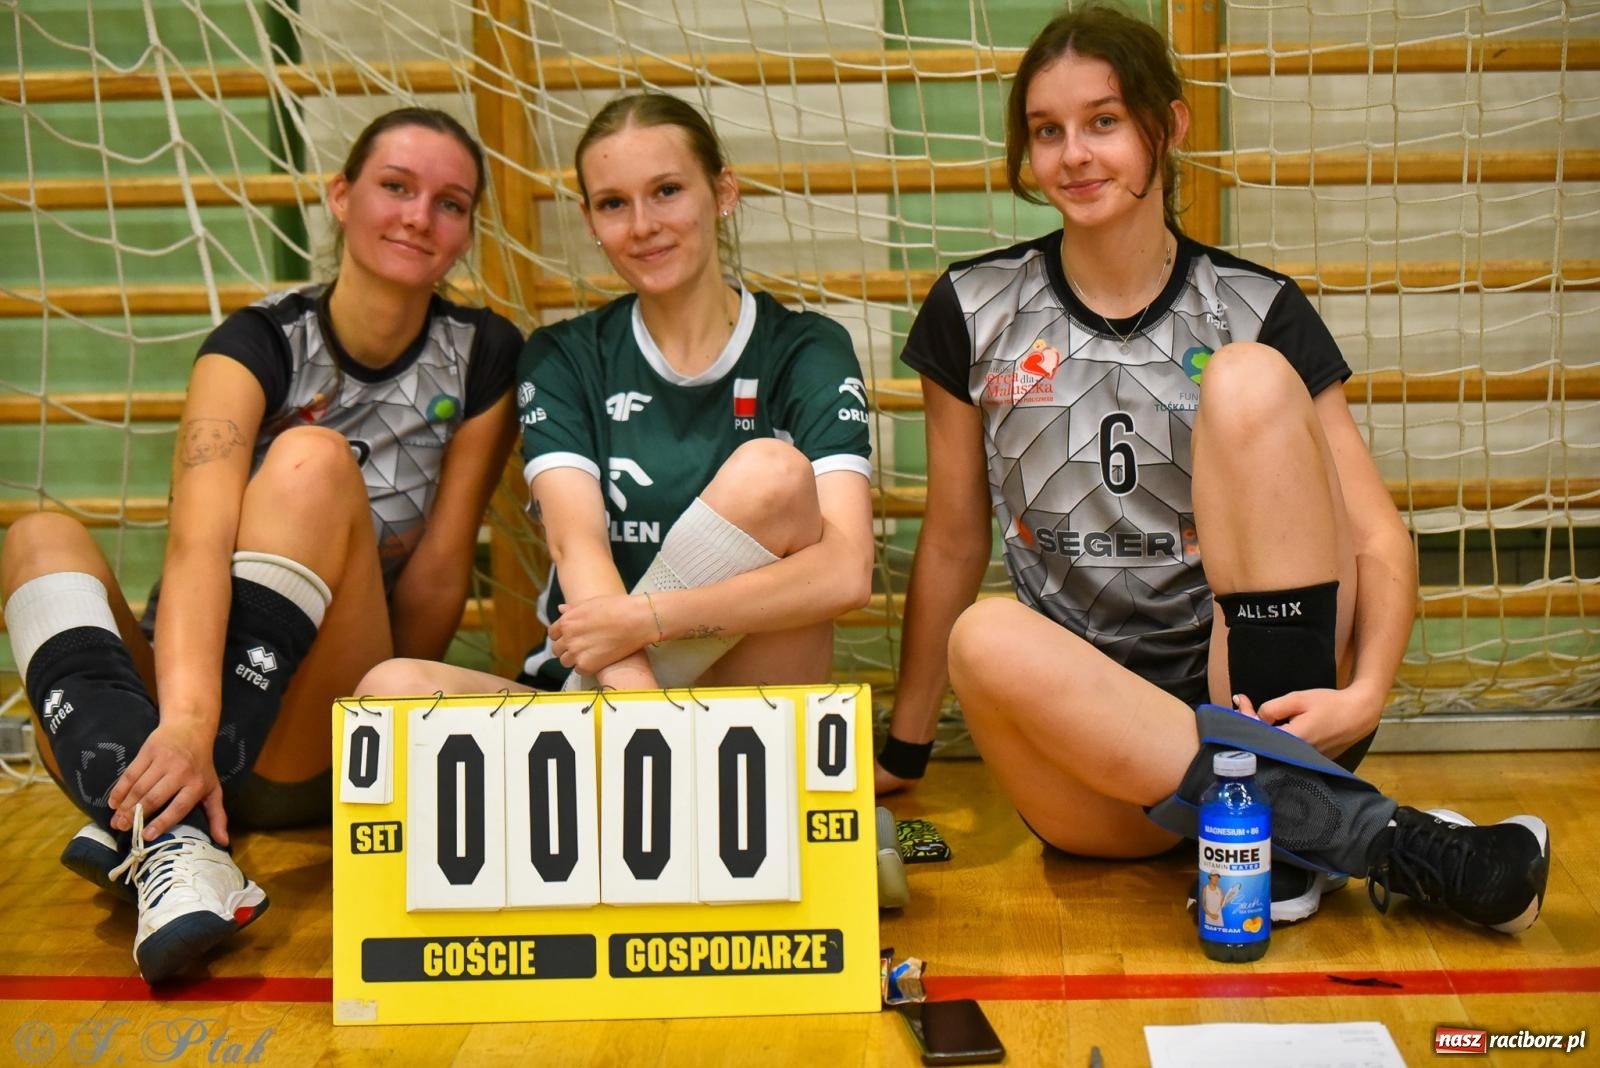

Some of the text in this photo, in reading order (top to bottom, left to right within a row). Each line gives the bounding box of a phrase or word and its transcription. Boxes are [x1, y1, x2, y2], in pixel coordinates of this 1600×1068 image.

[986, 383, 1054, 401] Maluszka
[1020, 374, 1035, 384] dla
[1180, 392, 1199, 401] FUN
[1098, 411, 1138, 497] 6
[1035, 527, 1176, 558] SEGER
[1237, 601, 1302, 619] ALLSIX
[235, 663, 271, 691] errea
[348, 725, 380, 788] 0
[817, 713, 847, 777] 0
[355, 823, 399, 853] SET
[811, 811, 855, 841] SET
[1204, 846, 1260, 863] OSHEE
[423, 937, 535, 976] GOŚCIE
[625, 935, 827, 973] GOSPODARZE
